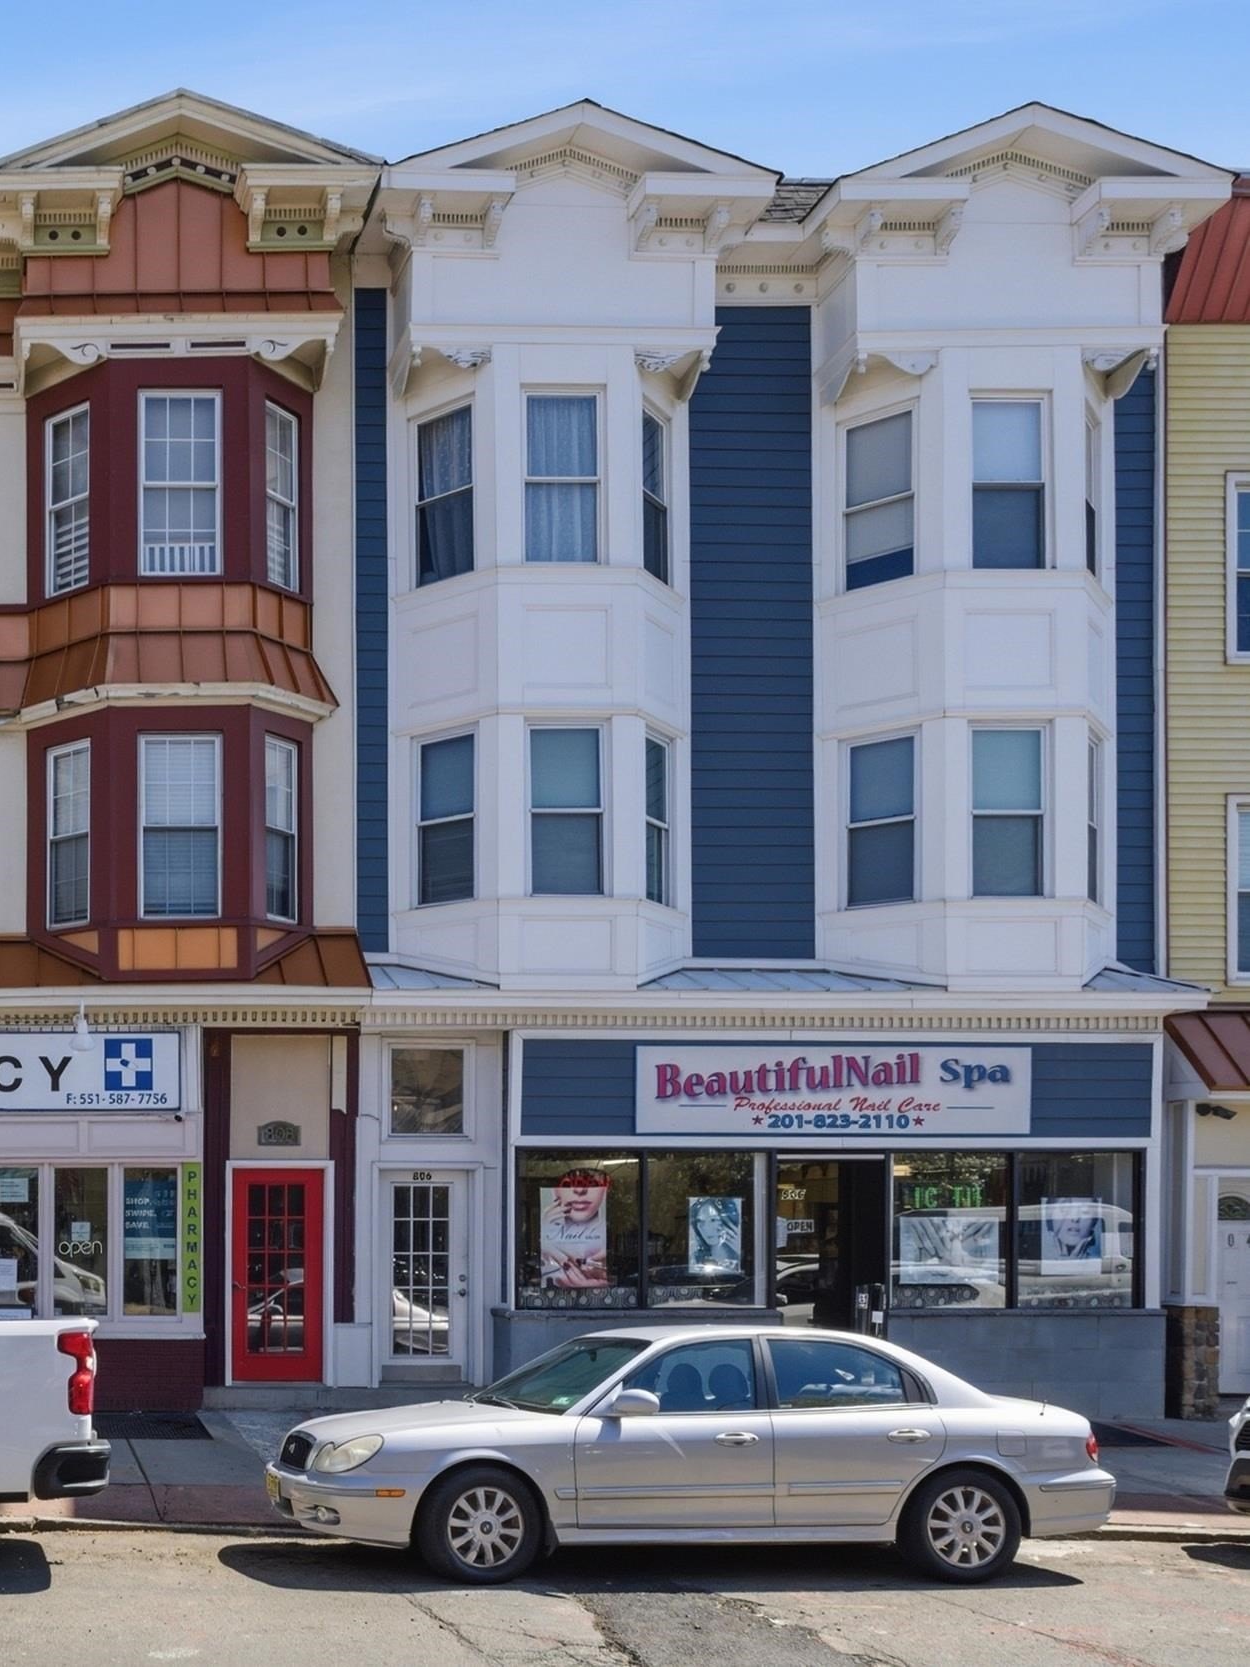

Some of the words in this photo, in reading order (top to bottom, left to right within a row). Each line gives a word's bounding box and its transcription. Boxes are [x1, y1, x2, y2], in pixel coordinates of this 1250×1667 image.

[939, 1058, 1012, 1090] Spa
[734, 1096, 842, 1115] Professional
[849, 1096, 892, 1112] Nail
[898, 1097, 942, 1113] Care
[767, 1114, 910, 1129] 201-823-2110
[412, 1171, 432, 1181] 806
[187, 1171, 197, 1305] PHARMACY
[58, 1241, 103, 1258] open
